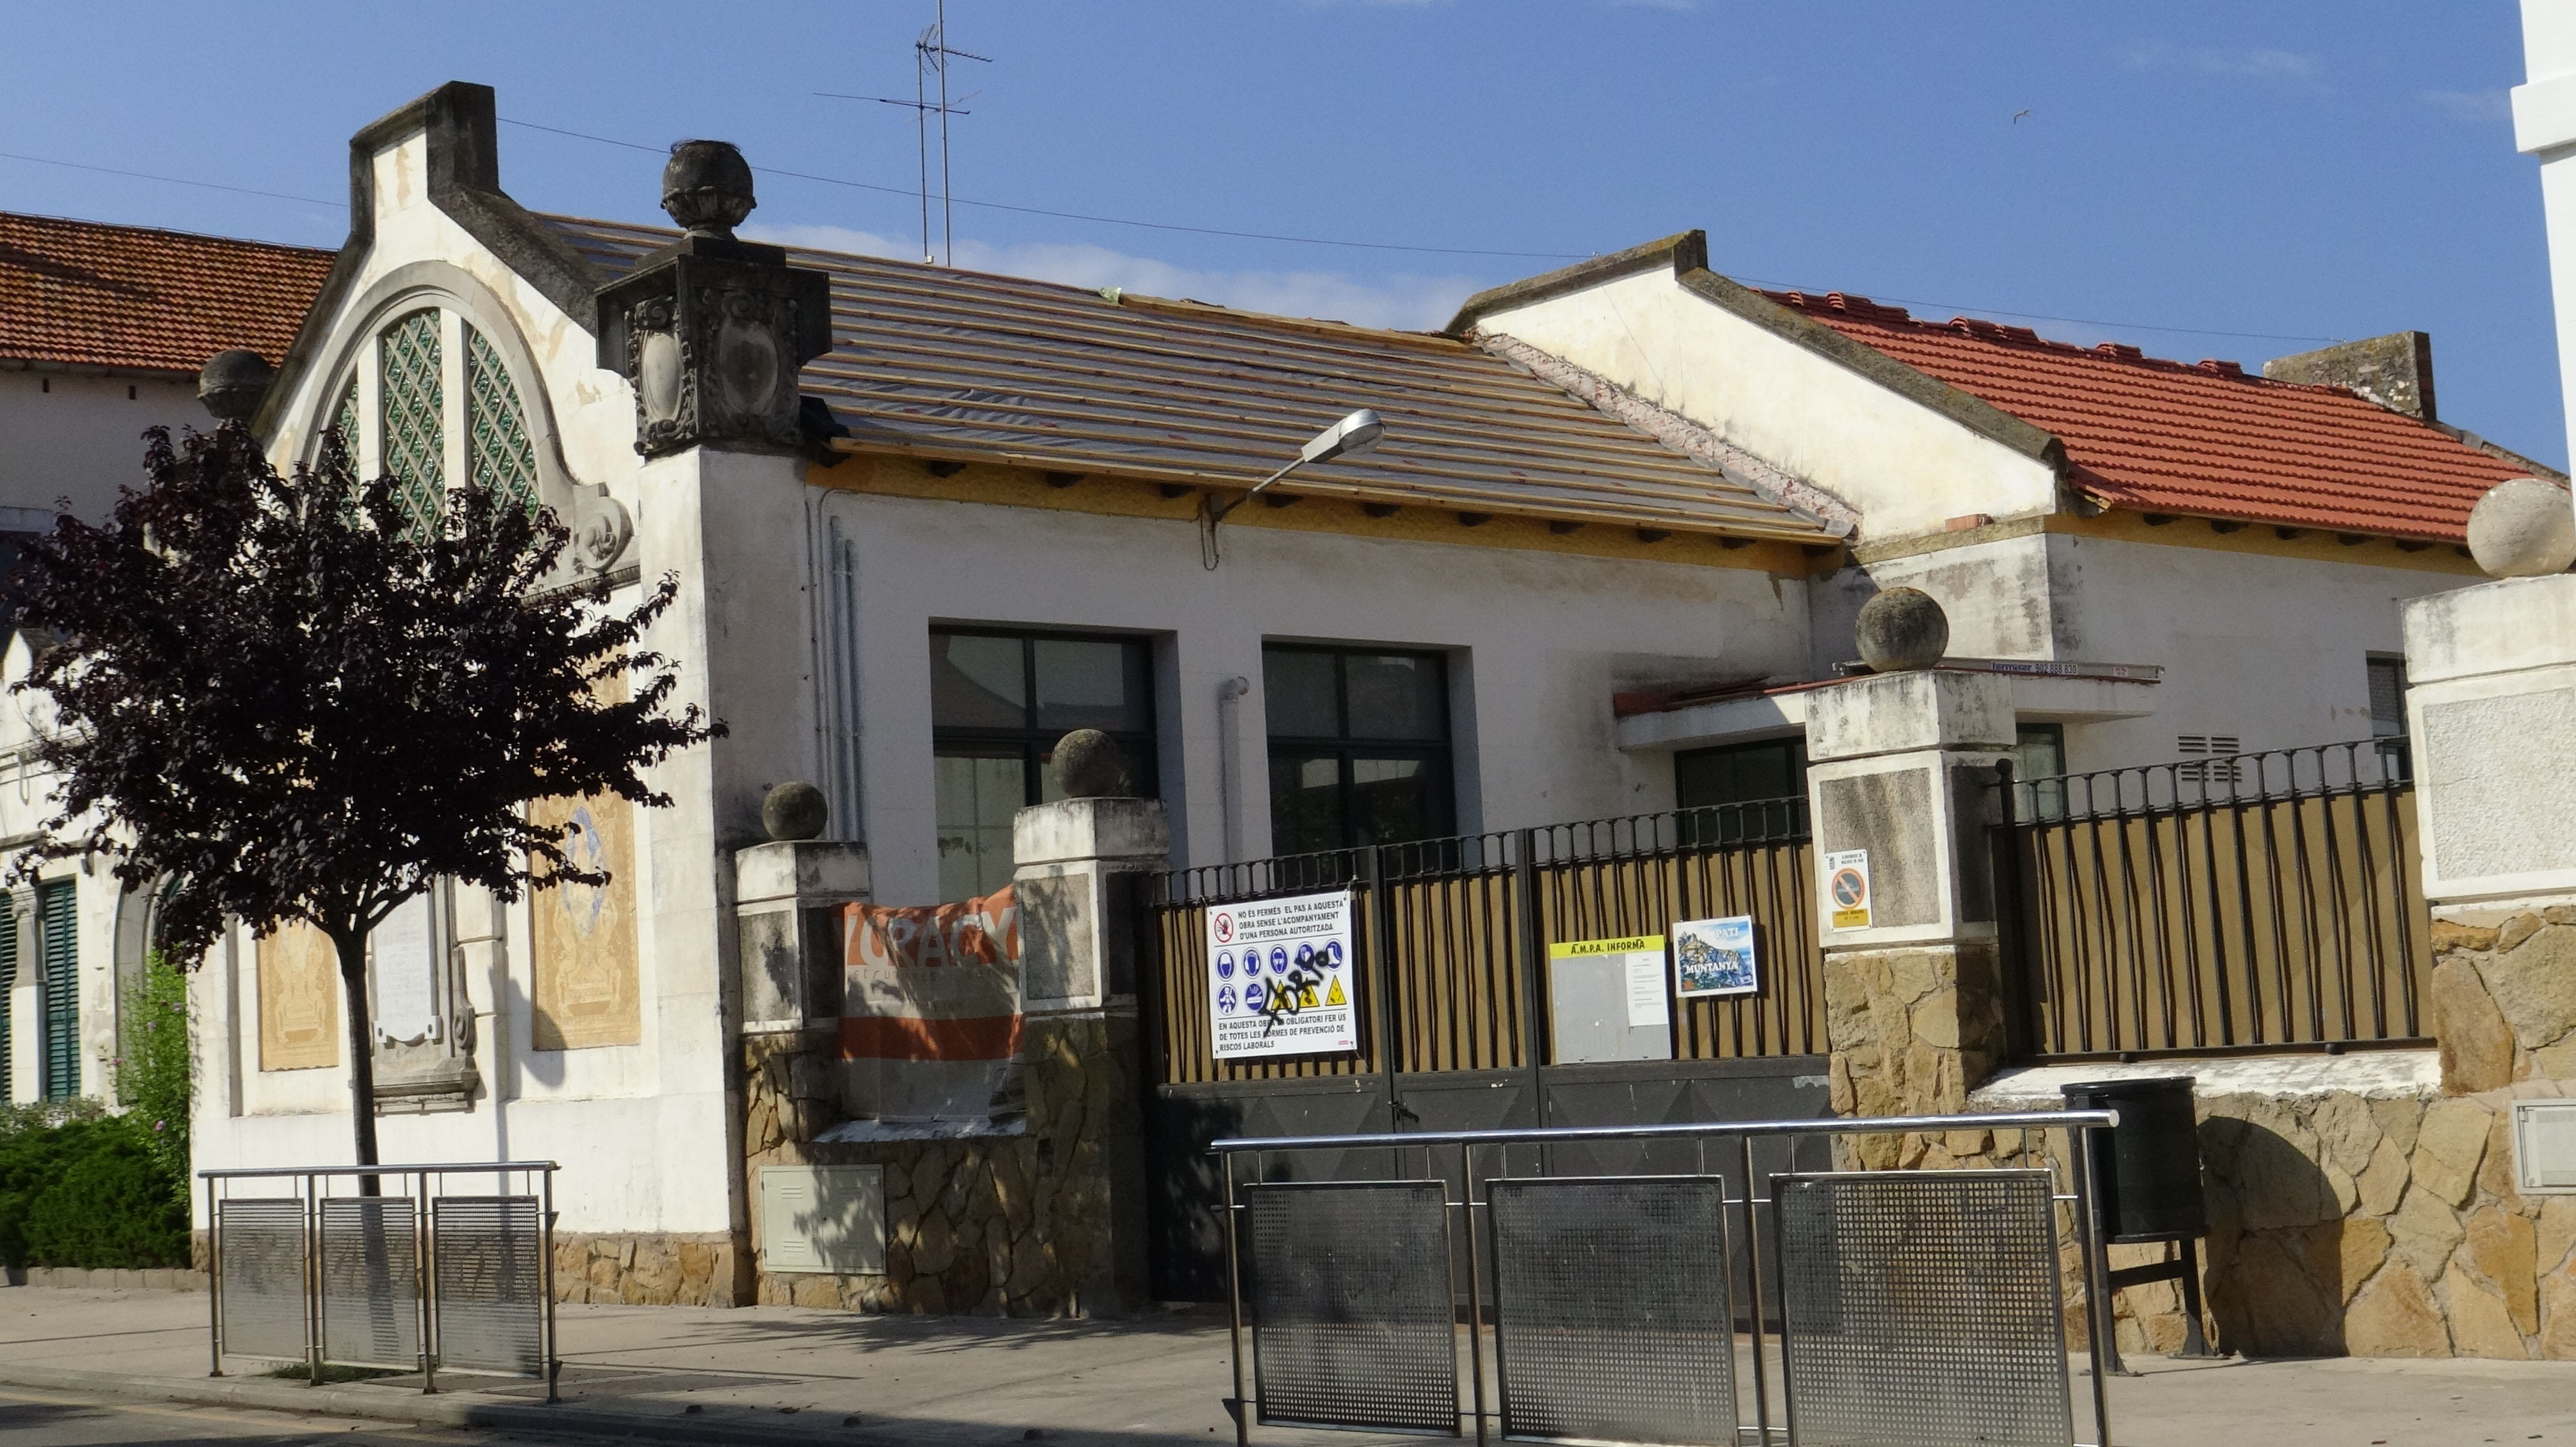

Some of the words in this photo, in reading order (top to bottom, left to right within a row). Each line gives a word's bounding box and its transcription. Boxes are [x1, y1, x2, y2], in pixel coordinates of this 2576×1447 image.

[2035, 663, 2048, 673] 902
[1314, 900, 1344, 910] AQUESTA
[1239, 921, 1254, 929] OBRA
[1256, 918, 1275, 927] SENSE
[1277, 911, 1339, 925] L'ACOMPANYAMENT
[1239, 931, 1258, 940] D'UNA
[1259, 928, 1288, 937] PERSONA
[1289, 923, 1333, 934] AUTORITZADA
[1715, 927, 1739, 939] PATI
[1607, 939, 1645, 952] INFORMA
[1685, 961, 1739, 973] MUNTANYA
[1229, 1020, 1257, 1029] AQUESTA
[1286, 1015, 1323, 1025] OBLIGATORI
[1229, 1031, 1248, 1040] TOTES
[1299, 1023, 1335, 1035] PREVENCIÓ
[1220, 1043, 1242, 1051] RISCOS
[1243, 1040, 1275, 1050] LABORALS
